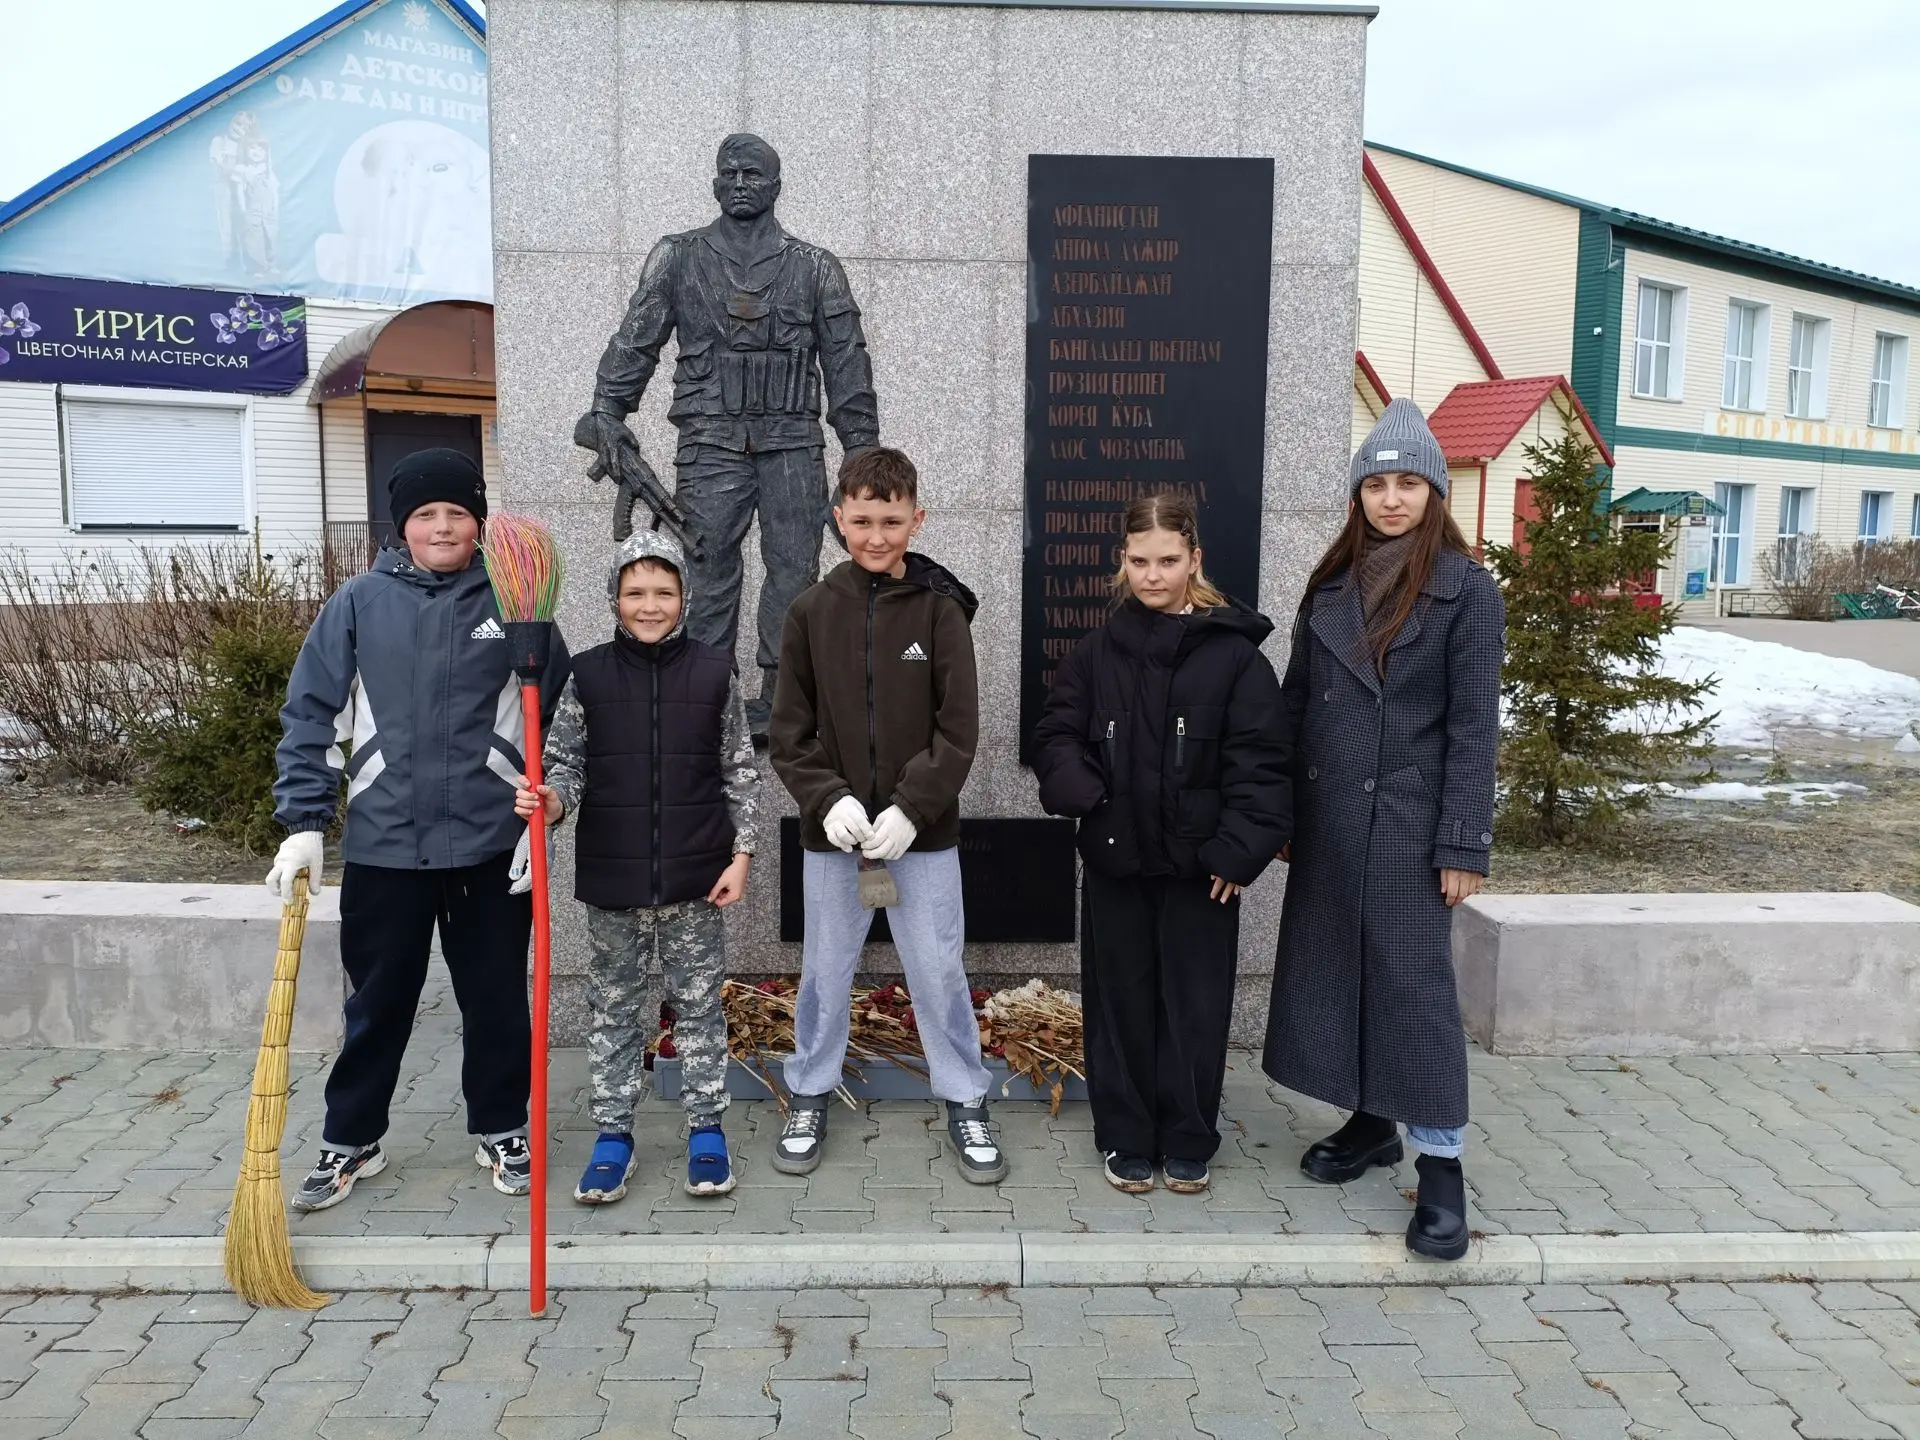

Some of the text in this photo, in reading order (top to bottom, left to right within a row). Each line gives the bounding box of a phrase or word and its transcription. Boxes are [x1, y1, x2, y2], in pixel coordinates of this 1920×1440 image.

[363, 29, 474, 65] МАГАЗИН
[340, 53, 488, 96] ДЕТСКОЙ
[275, 74, 413, 111] ОДЕЖДЫ
[419, 95, 436, 116] И
[1053, 205, 1159, 229] АФГАНИСТАН
[1052, 238, 1180, 262] АНГОЛА АЛЖИР
[1051, 268, 1174, 295] АЗЕРБАЙДЖАН
[74, 307, 195, 344] ИРИС
[1051, 306, 1126, 328] АБХАЗИЯ
[16, 341, 249, 369] ЦВЕТОЧНАЯ МАСТЕРСКАЯ
[1050, 339, 1222, 363] БАНГЛАДЕШ ВЬЕТНАМ
[1050, 372, 1168, 395] ГРУЗИЯ ЕГИПЕТ
[1049, 404, 1153, 428] КОРЕЯ КУБА
[1716, 413, 1917, 453] СПОРТИВНАЯ ШК
[1050, 438, 1186, 460] ЛАОС МОЗАМБИК
[1046, 475, 1131, 501] НАГОРНЫЙ
[1045, 512, 1129, 534] ПРИДНЕСТ
[1044, 543, 1099, 566] СИРИЯ
[1044, 607, 1113, 629] УКРАИН
[471, 630, 506, 639] adidas
[900, 653, 928, 661] adidas
